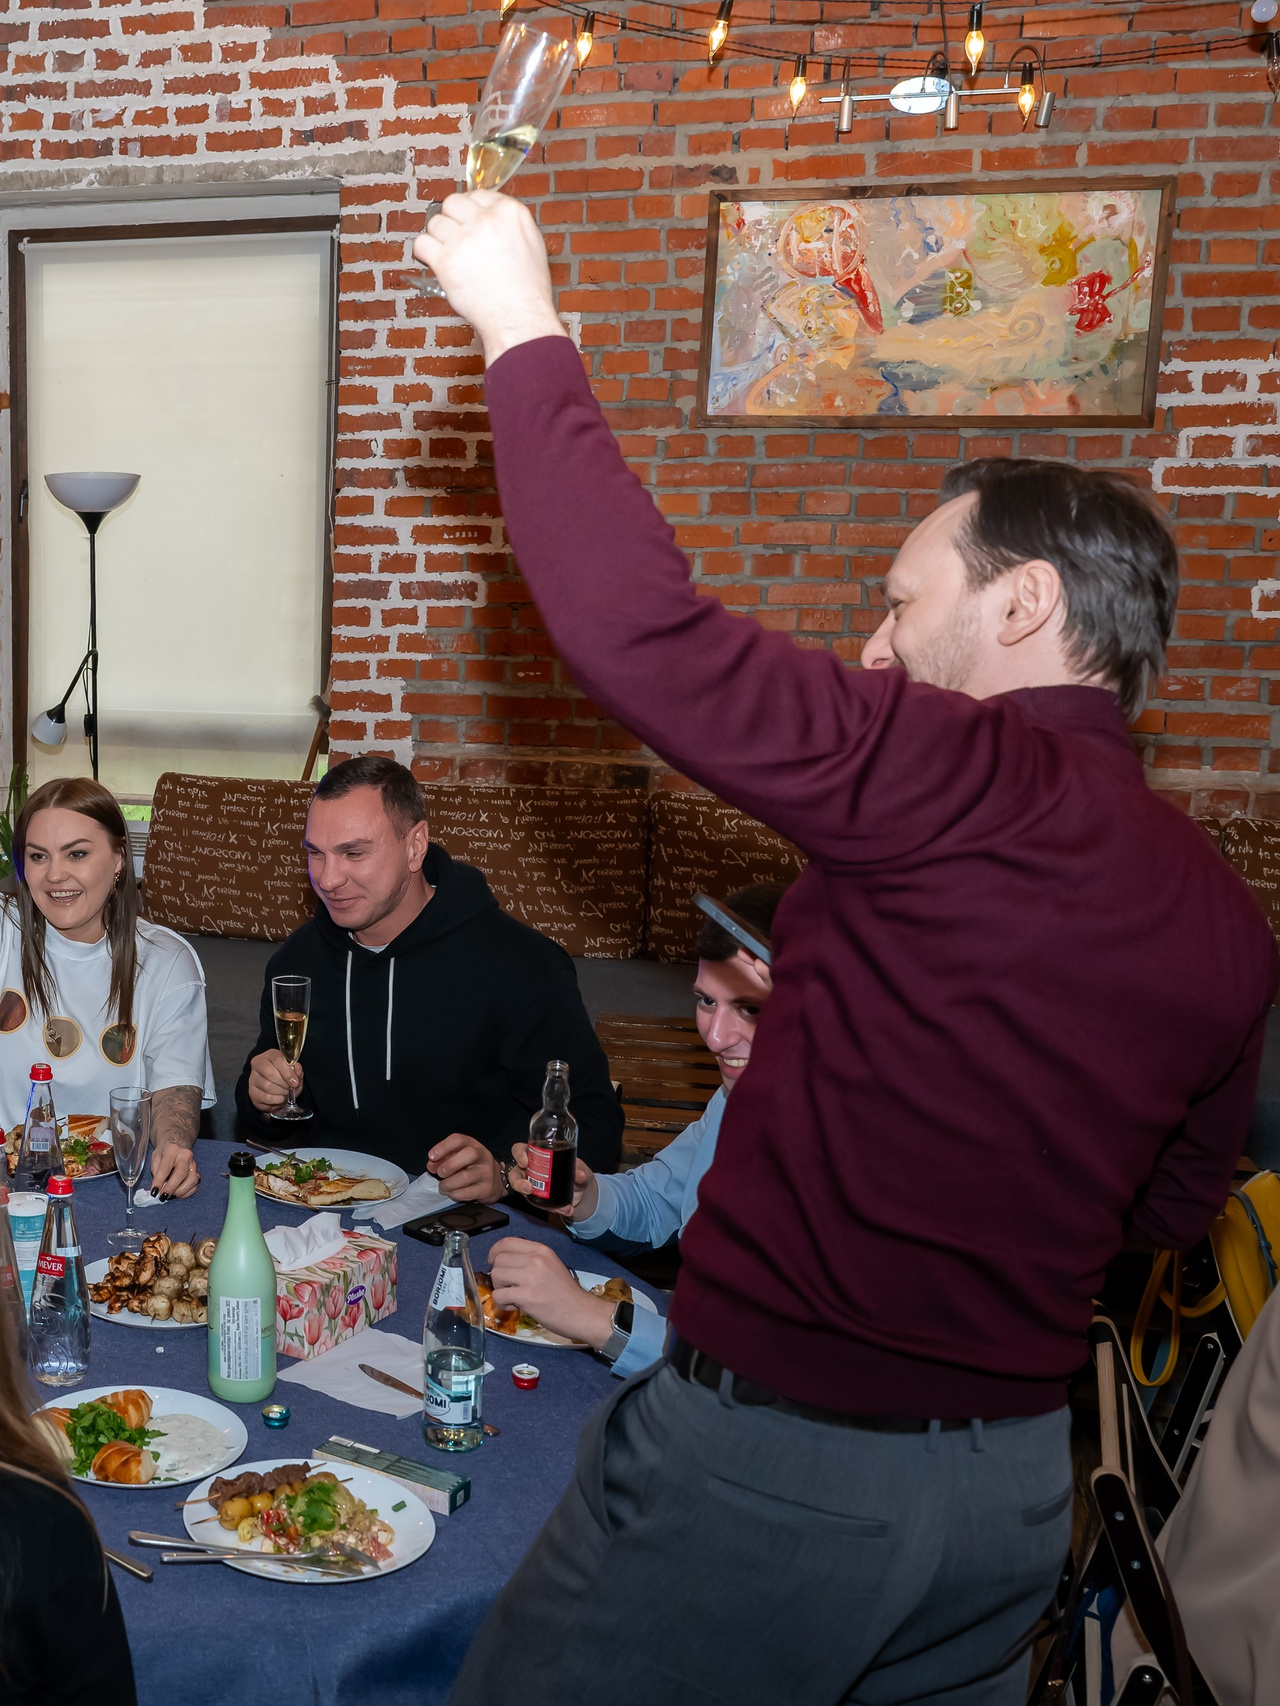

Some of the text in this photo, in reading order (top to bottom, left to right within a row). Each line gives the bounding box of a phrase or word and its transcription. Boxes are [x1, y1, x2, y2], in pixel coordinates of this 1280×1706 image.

[38, 1260, 63, 1272] MEVER
[432, 1267, 446, 1306] BORJOMI
[425, 1394, 447, 1409] JOMI
